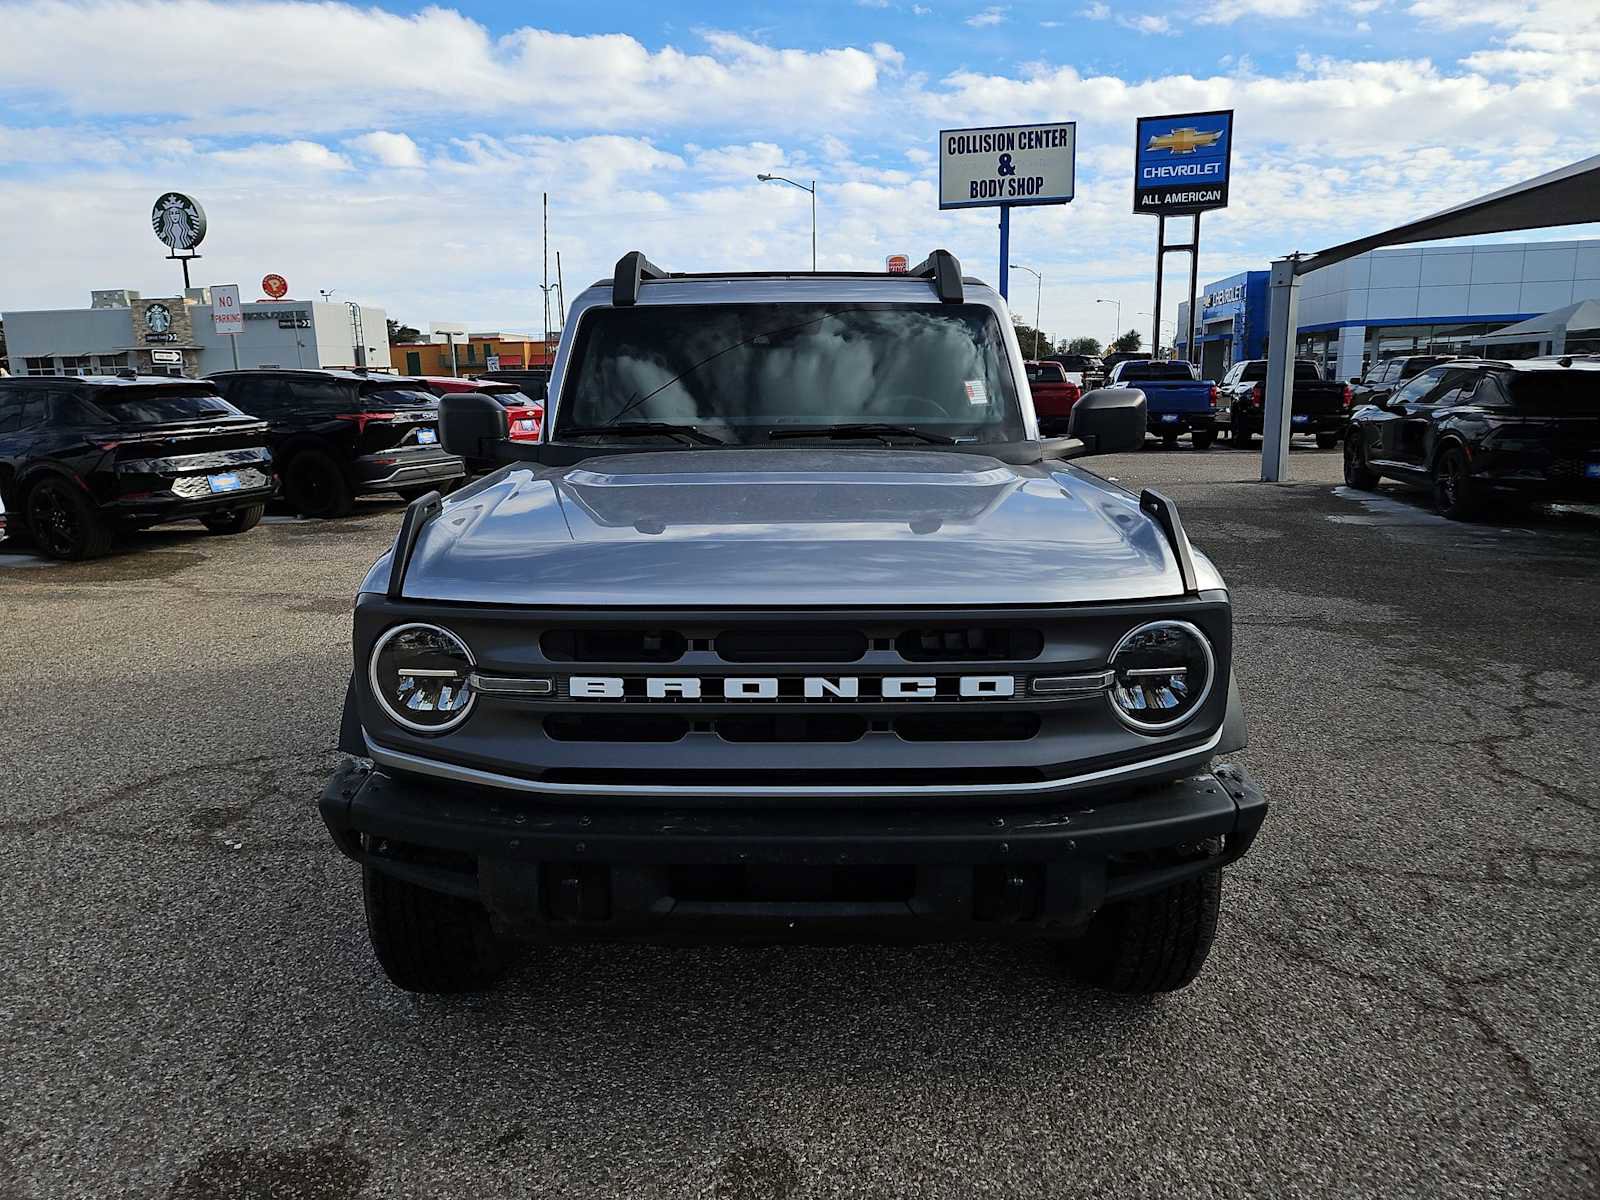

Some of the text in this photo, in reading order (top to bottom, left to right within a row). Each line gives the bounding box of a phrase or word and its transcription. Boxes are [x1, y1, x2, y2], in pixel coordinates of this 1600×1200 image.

[948, 128, 1067, 155] COLLISION CENTER
[998, 153, 1016, 176] &
[1143, 162, 1222, 179] CHEVROLET
[970, 176, 1044, 199] BODY SHOP
[1141, 190, 1221, 206] ALL AMERICAN
[219, 296, 233, 307] NO
[215, 312, 241, 323] PARKING
[569, 676, 1015, 698] BRONCO
